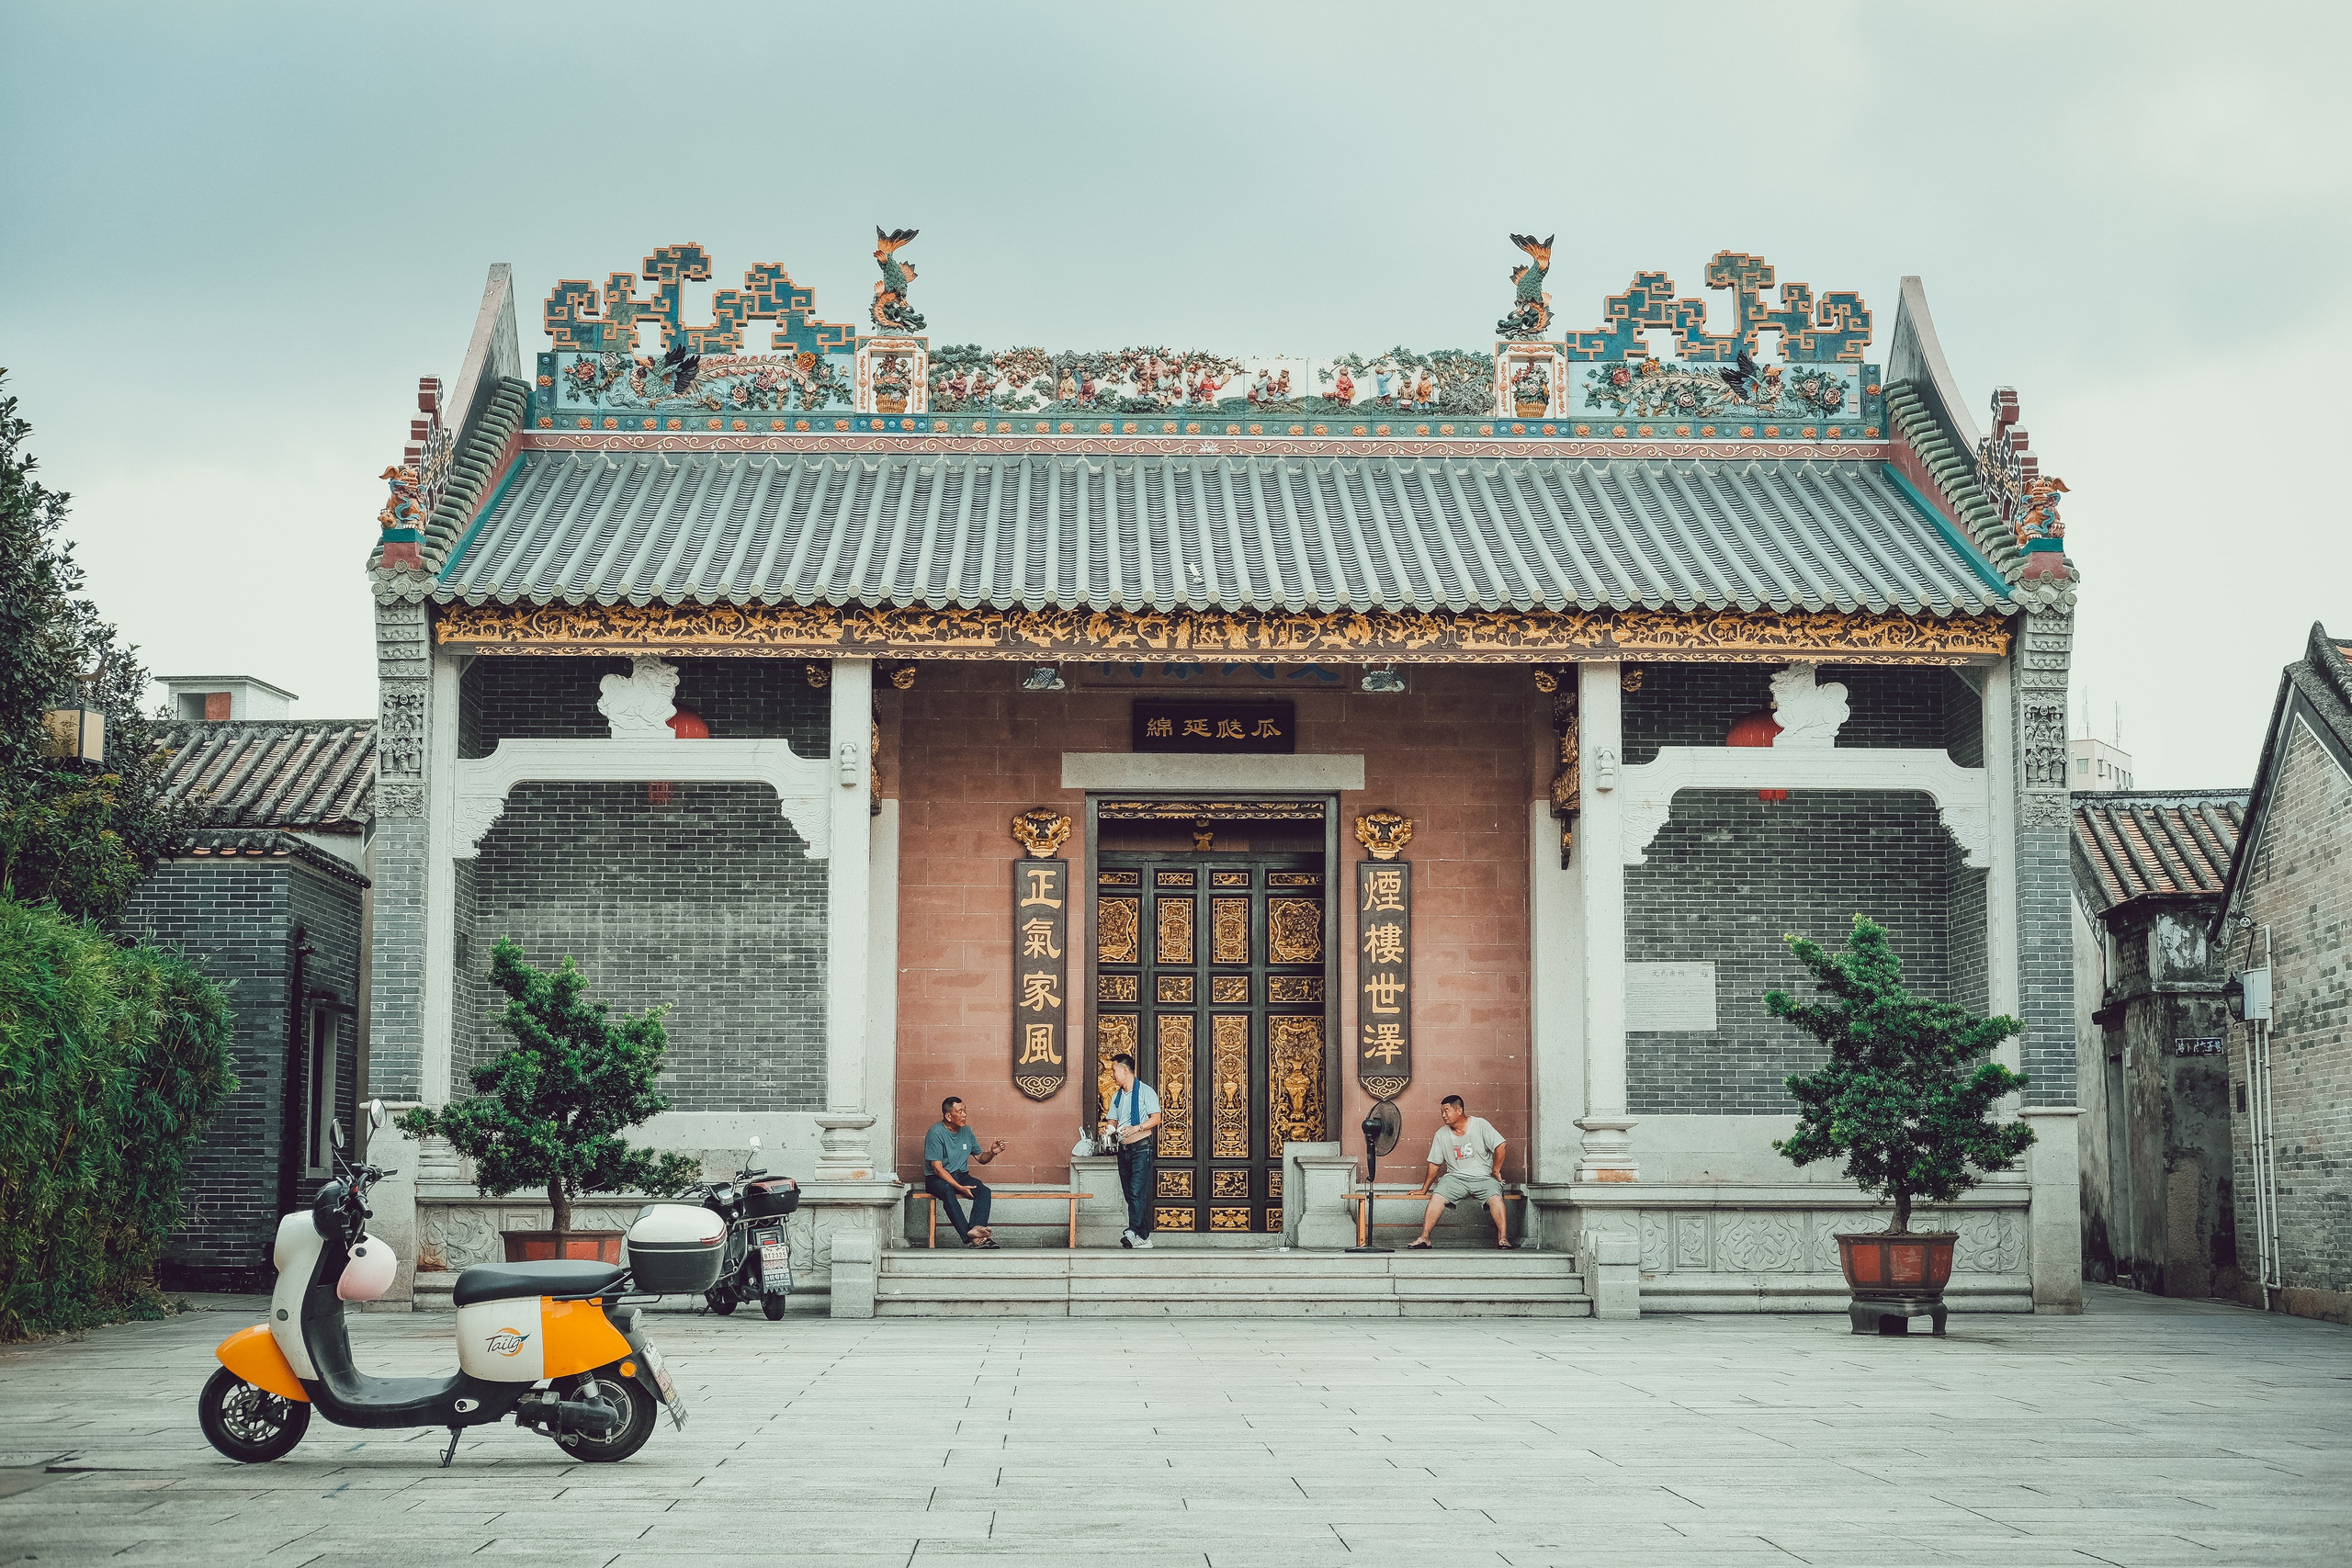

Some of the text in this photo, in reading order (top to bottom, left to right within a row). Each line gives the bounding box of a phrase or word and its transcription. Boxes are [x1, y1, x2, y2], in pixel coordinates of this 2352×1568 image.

[1019, 869, 1062, 1065] 正氣家風
[1363, 870, 1406, 1065] 煙樓世澤
[485, 1334, 527, 1353] Tailg
